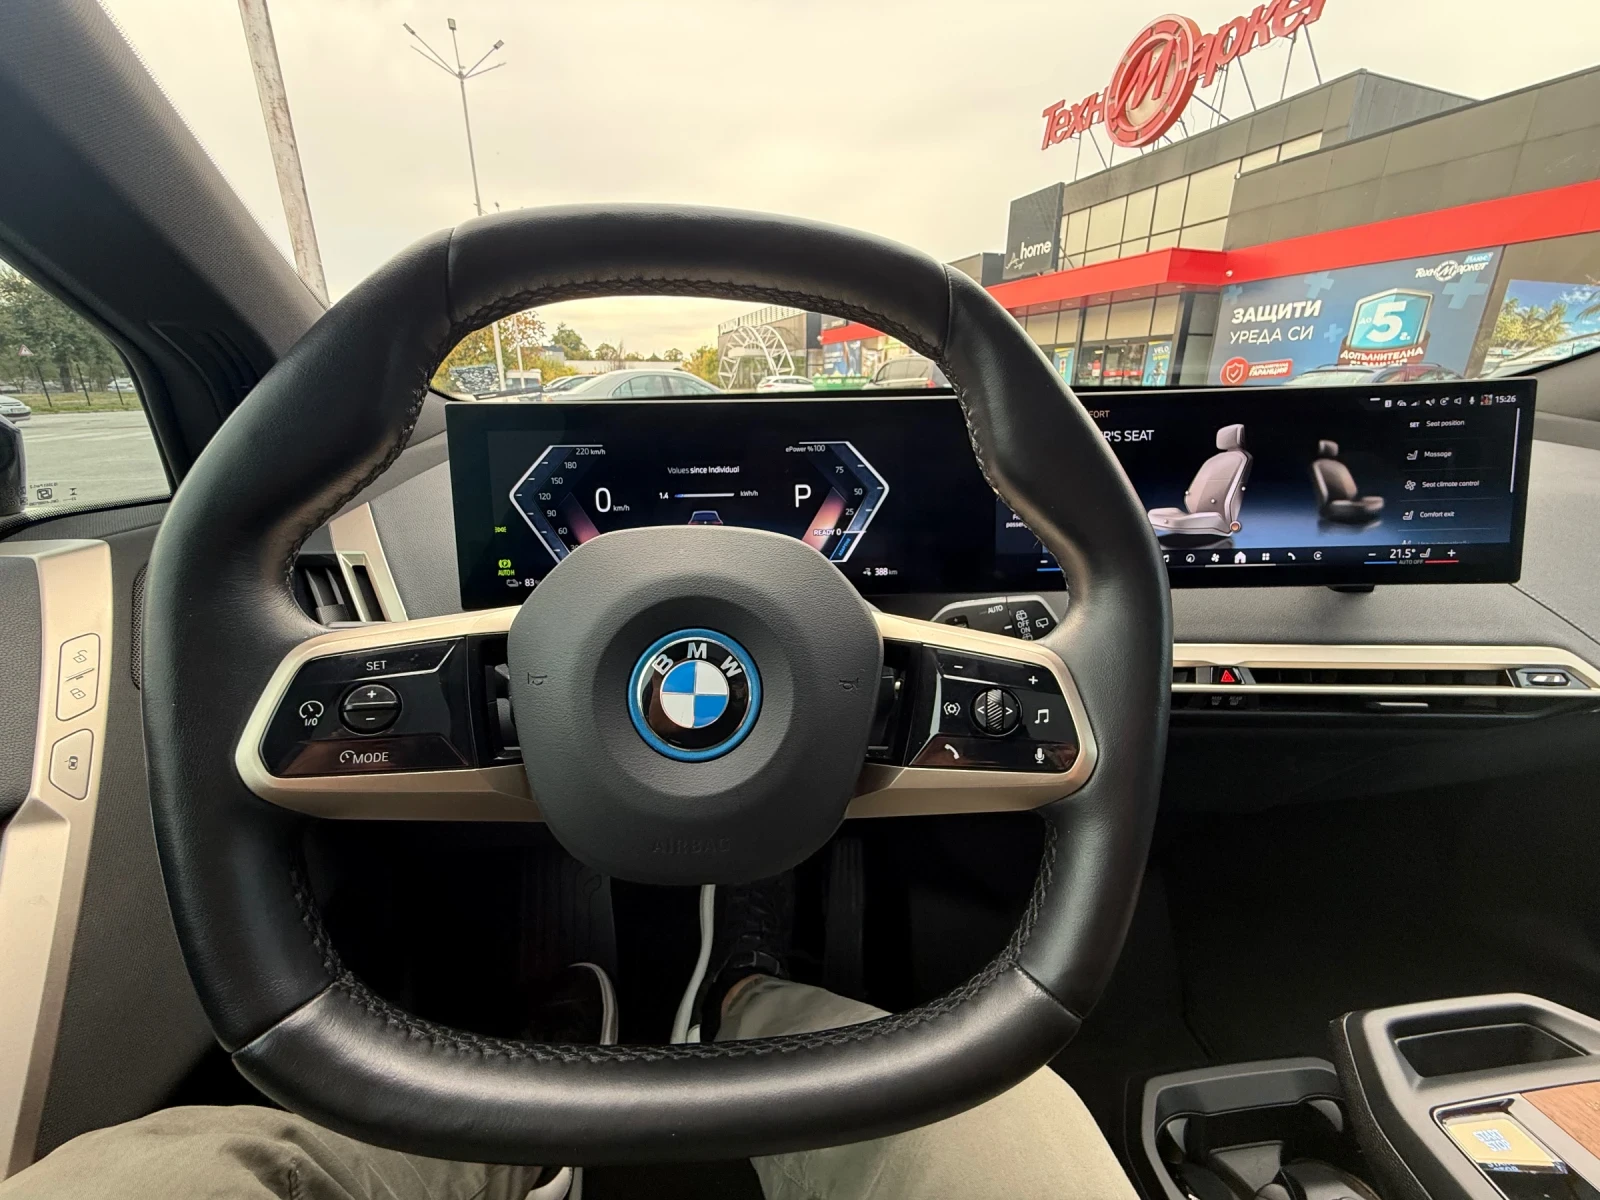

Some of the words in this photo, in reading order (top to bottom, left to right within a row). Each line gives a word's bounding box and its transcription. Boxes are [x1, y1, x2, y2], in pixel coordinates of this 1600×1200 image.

[1020, 241, 1052, 260] home
[1231, 299, 1322, 324] ЗАЩИТИ
[1366, 301, 1407, 343] 5
[1229, 327, 1283, 345] УРЕДА
[1287, 324, 1315, 341] СИ
[1340, 347, 1424, 361] ДОПЪЛНИТЕЛНА
[1494, 395, 1517, 403] 15:26
[1441, 419, 1465, 428] position
[1124, 429, 1155, 442] SEAT
[575, 448, 590, 456] 220
[590, 448, 606, 456] km/h
[814, 444, 826, 452] 100
[564, 461, 577, 470] 180
[835, 466, 845, 474] 75
[667, 467, 690, 475] Values
[708, 466, 740, 474] Individual
[551, 477, 564, 485] 150
[1436, 480, 1458, 488] climate
[659, 492, 669, 500] 1.4
[794, 484, 812, 508] P
[853, 488, 863, 496] 50
[538, 493, 552, 501] 120
[595, 487, 612, 513] 0
[613, 504, 630, 512] km/h
[546, 509, 557, 517] 90
[845, 508, 855, 516] 25
[558, 527, 568, 535] 60
[813, 529, 836, 537] READY
[1390, 548, 1416, 559] 21.5°
[874, 567, 889, 576] 388
[524, 578, 535, 587] 83
[987, 604, 1004, 614] AUTO
[1017, 620, 1030, 628] OFF
[1020, 626, 1031, 634] ON
[651, 641, 743, 678] BMW
[366, 660, 388, 671] SET
[352, 751, 390, 764] MODE
[1473, 1129, 1503, 1142] START
[1488, 1140, 1511, 1151] STOP
